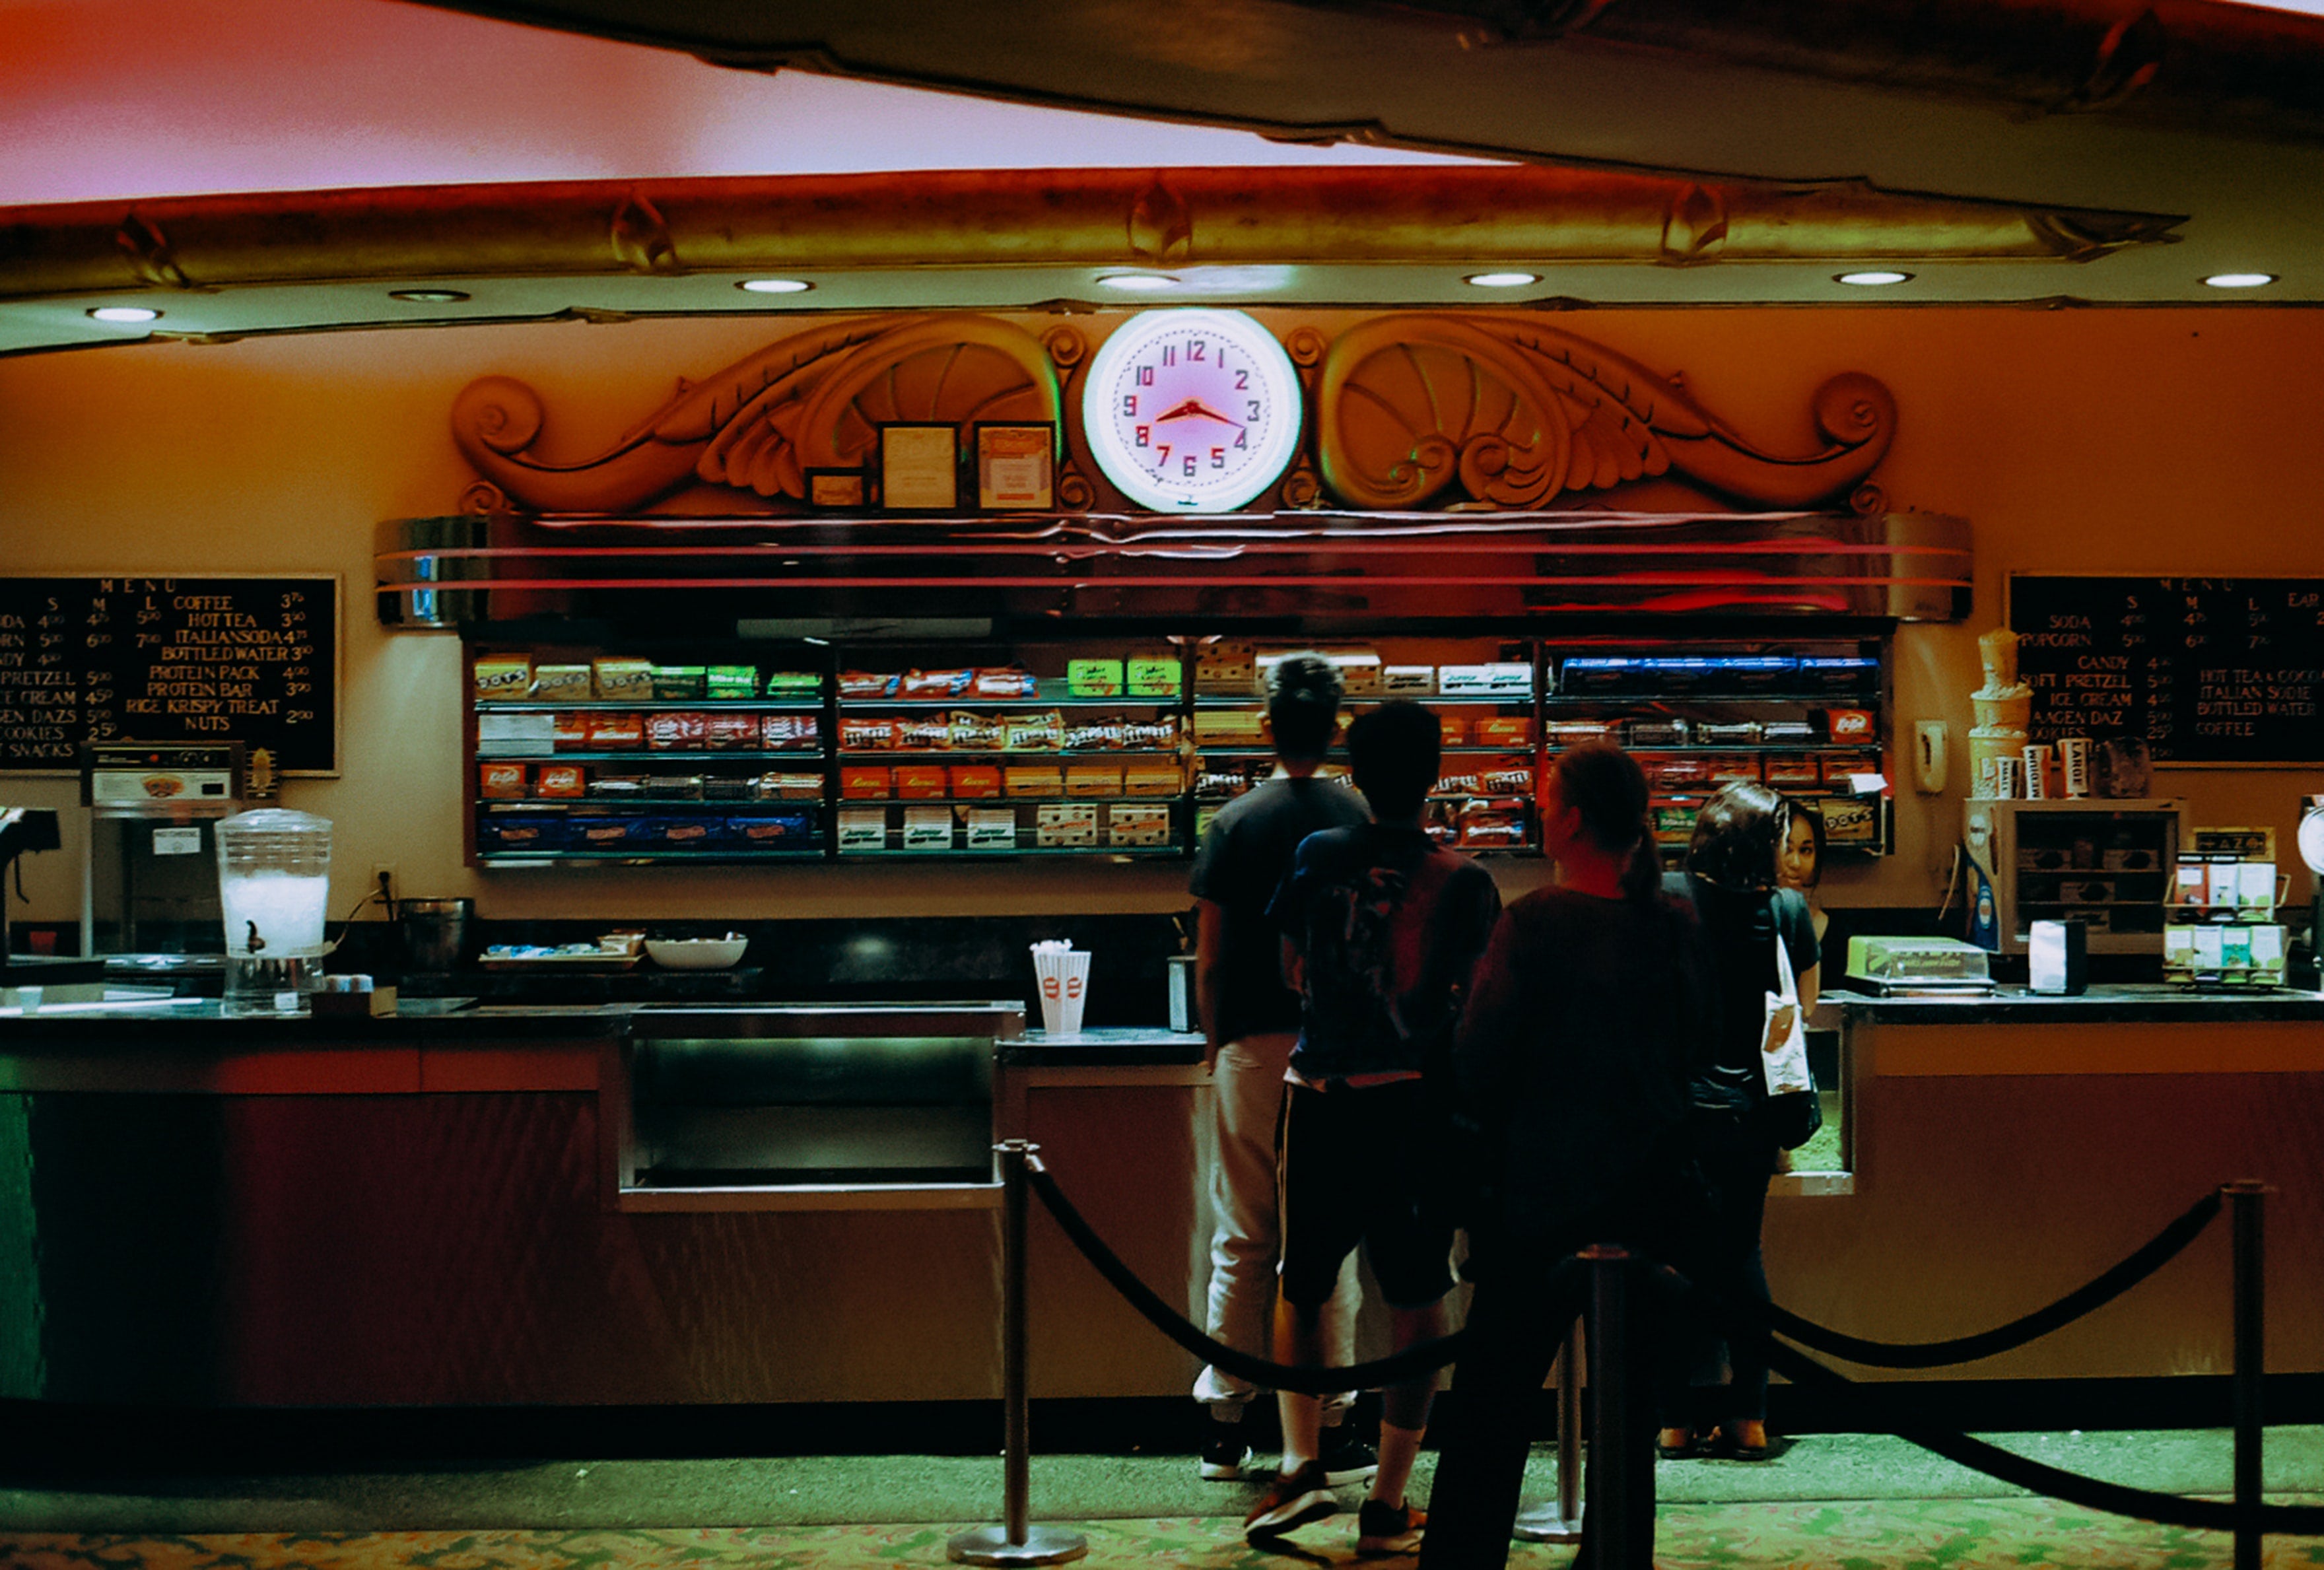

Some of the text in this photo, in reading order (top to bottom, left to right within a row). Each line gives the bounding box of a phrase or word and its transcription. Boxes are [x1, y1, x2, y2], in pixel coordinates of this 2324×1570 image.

[1163, 345, 1175, 366] 11
[1187, 341, 1205, 361] 12
[1219, 348, 1223, 368] 1
[1136, 366, 1153, 386] 10
[1235, 370, 1248, 390] 2
[1124, 395, 1137, 417] 9
[1247, 401, 1260, 421] 3
[1136, 426, 1149, 447] 8
[1235, 428, 1247, 450] 4
[1157, 446, 1171, 467] 7
[1212, 448, 1224, 468] 5
[1184, 456, 1196, 477] 6
[100, 579, 177, 593] MENU
[48, 596, 156, 611] S M L
[173, 596, 233, 611] COFFEE
[2127, 595, 2138, 609] S
[2248, 597, 2260, 611] L
[188, 613, 221, 628] HOT
[224, 613, 257, 628] TEA
[2049, 614, 2092, 629] SODA
[2020, 632, 2092, 647] POPCORN
[161, 646, 233, 662] BOTTLED
[235, 646, 289, 662] WATER
[2077, 655, 2130, 670] CANDY
[1, 671, 77, 686] PRETZEL
[149, 665, 216, 680] PROTEIN
[219, 665, 260, 680] PACK
[2200, 669, 2228, 683] HOT
[2232, 669, 2263, 683] TEA
[2020, 673, 2057, 688] SOFT
[2065, 673, 2132, 689] PRETZEL
[20, 690, 77, 705] CREAM
[219, 682, 253, 697] BAR
[2201, 685, 2262, 700] ITALIAN
[125, 699, 161, 714] RICE
[167, 699, 224, 714] KRISPY
[227, 699, 279, 715] TREAT
[2050, 692, 2074, 706] ICE
[2080, 692, 2132, 706] CREAM
[32, 709, 77, 724] DAZS
[2197, 701, 2316, 716] BOTTLED WATER
[185, 716, 230, 731] NUTS
[2090, 710, 2123, 726] DAZ
[2196, 721, 2255, 736] COFFEE
[9, 742, 74, 758] SNACKS
[2072, 742, 2082, 785] LARGE
